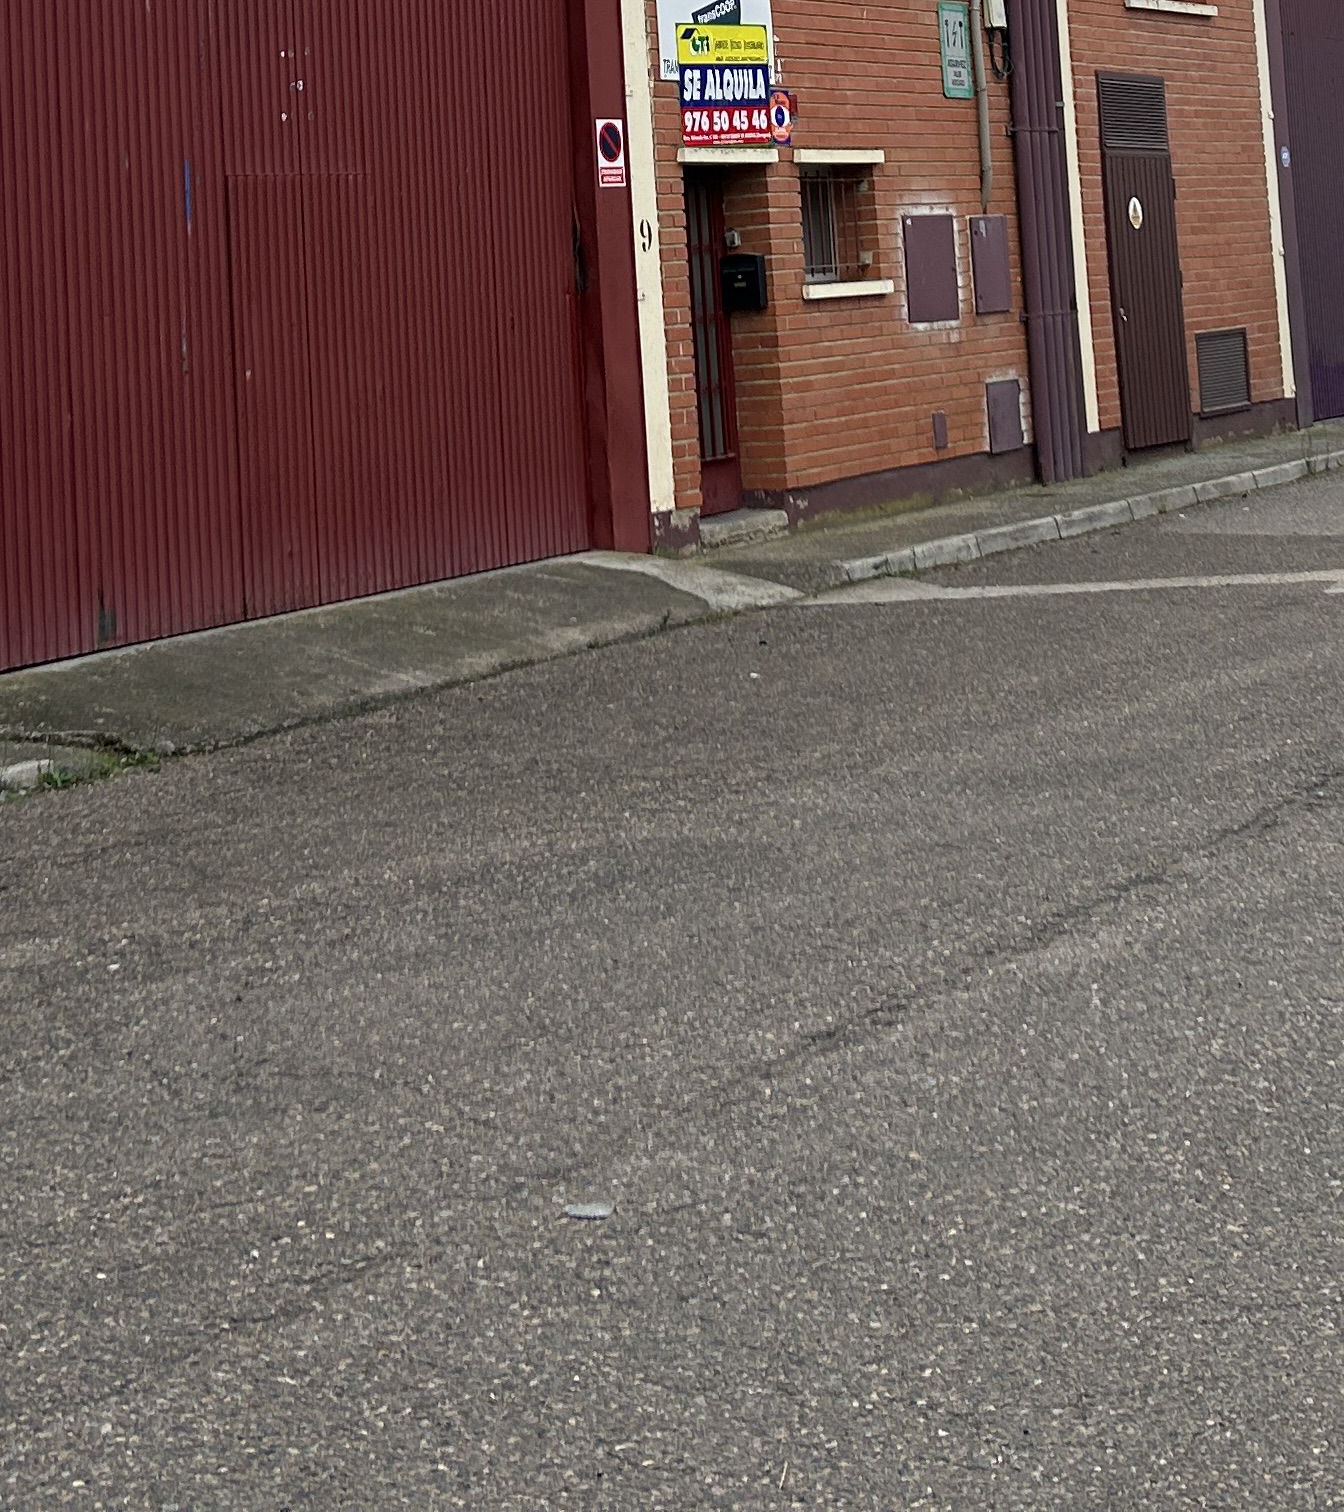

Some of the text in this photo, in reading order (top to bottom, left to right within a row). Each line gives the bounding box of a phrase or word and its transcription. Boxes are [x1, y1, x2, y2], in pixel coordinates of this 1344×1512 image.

[683, 69, 701, 101] SE
[704, 68, 766, 101] ALQUILA
[684, 109, 768, 132] 976 50 45 46
[639, 219, 652, 252] 9
